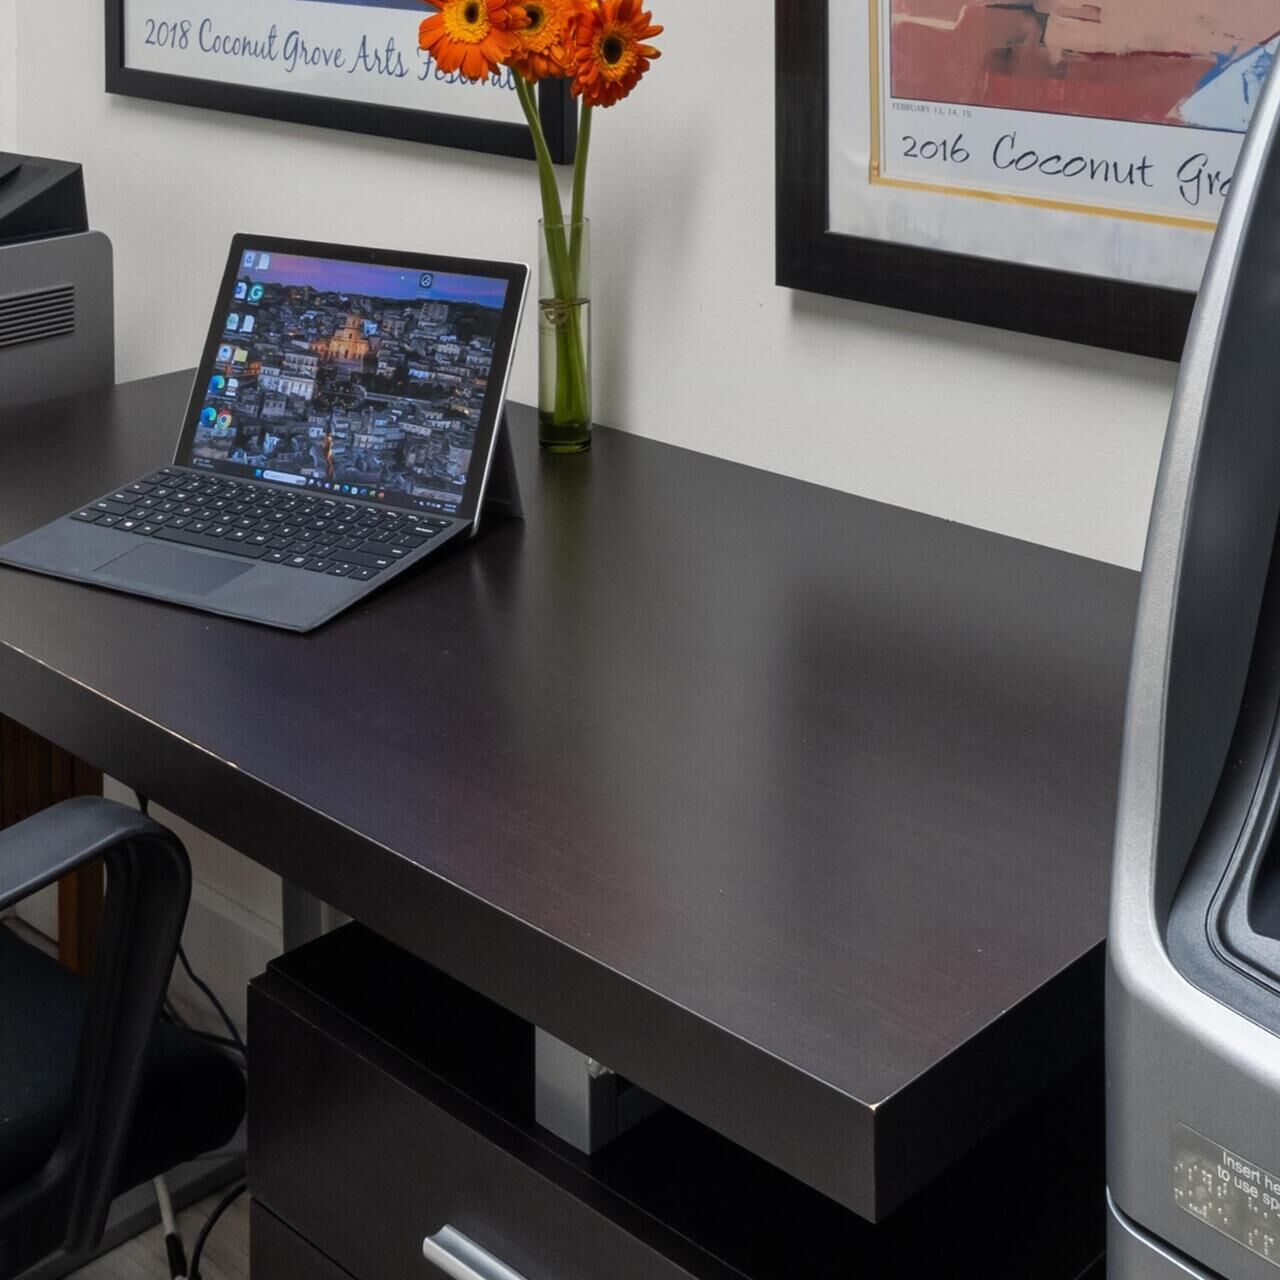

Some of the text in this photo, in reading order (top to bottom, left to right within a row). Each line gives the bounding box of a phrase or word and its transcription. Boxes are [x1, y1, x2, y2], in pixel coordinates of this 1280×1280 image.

[144, 18, 192, 50] 2018
[198, 17, 279, 62] Coconut
[282, 29, 347, 73] Grove
[347, 34, 410, 78] Arts
[902, 133, 970, 164] 2016
[992, 131, 1154, 188] Coconut
[1217, 1163, 1231, 1182] to
[1234, 1176, 1259, 1199] use
[1223, 1151, 1261, 1185] Insert
